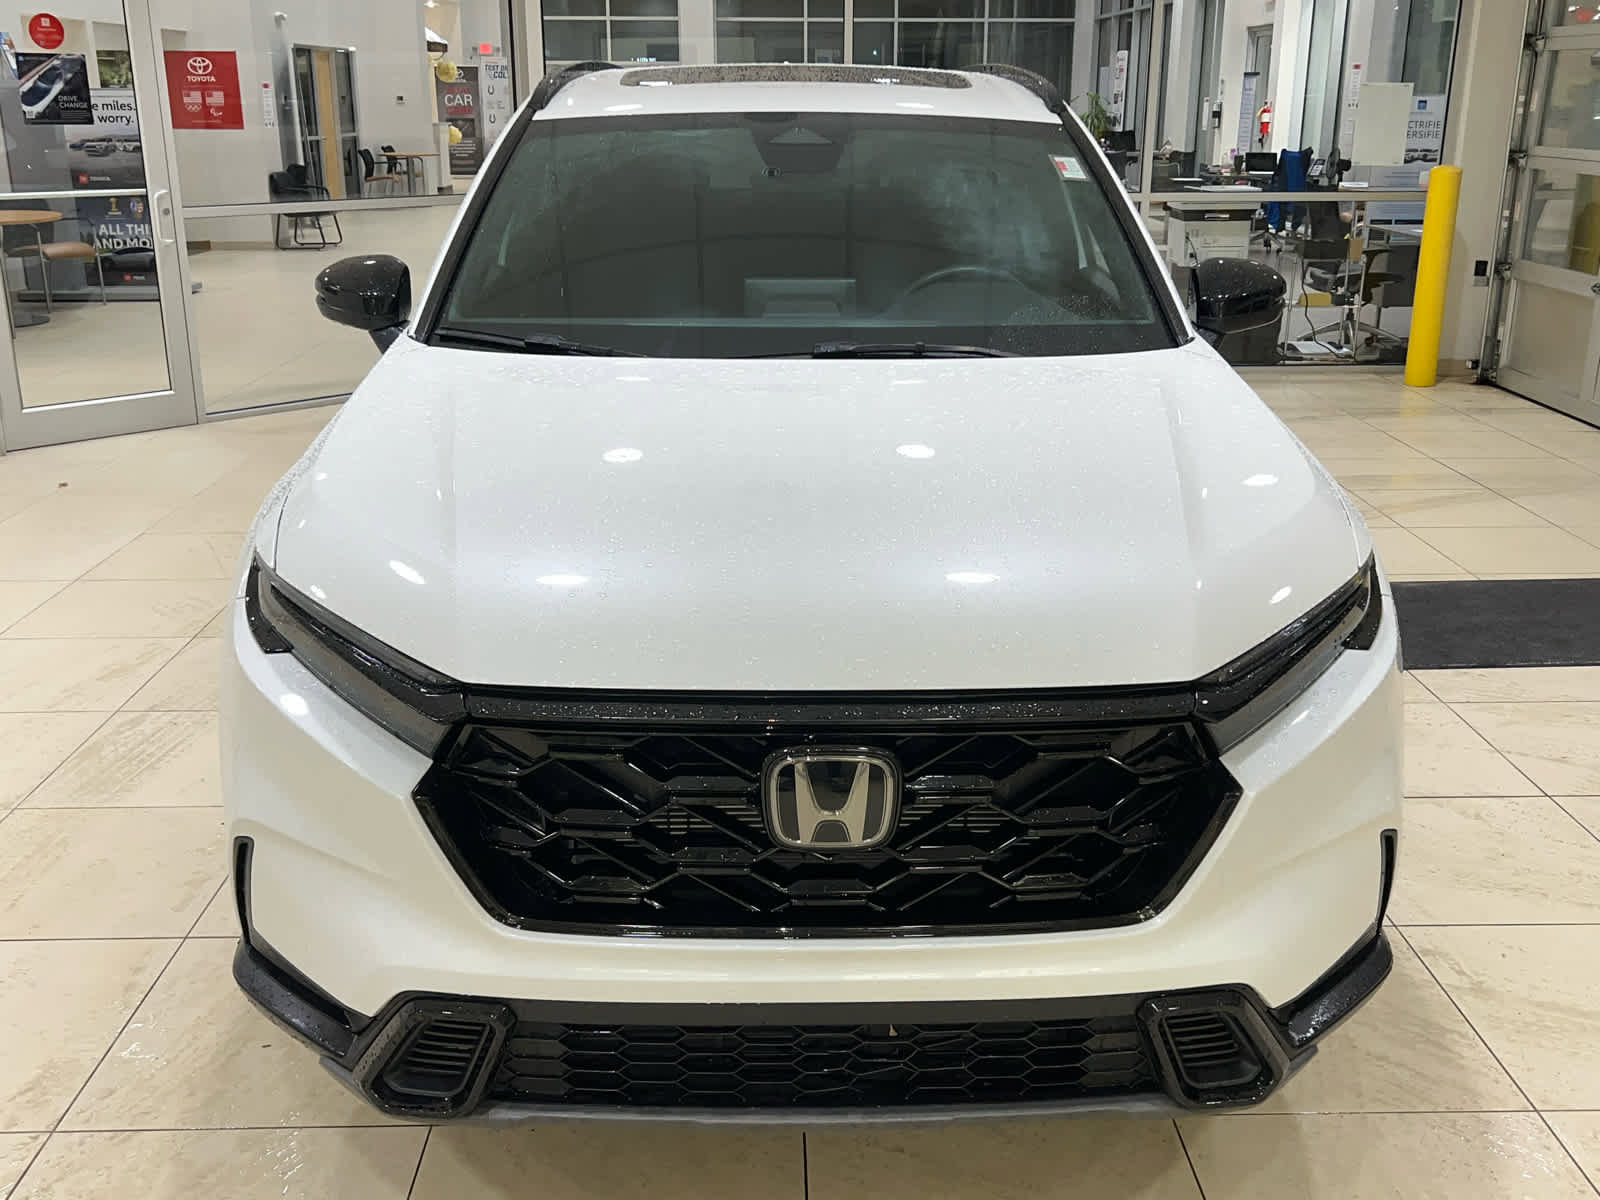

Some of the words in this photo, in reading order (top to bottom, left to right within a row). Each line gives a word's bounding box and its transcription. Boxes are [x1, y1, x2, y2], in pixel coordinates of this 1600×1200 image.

[102, 100, 136, 111] miles.
[444, 93, 473, 107] CAR
[97, 114, 135, 126] worry.
[99, 223, 124, 236] ALL
[93, 237, 123, 249] AND
